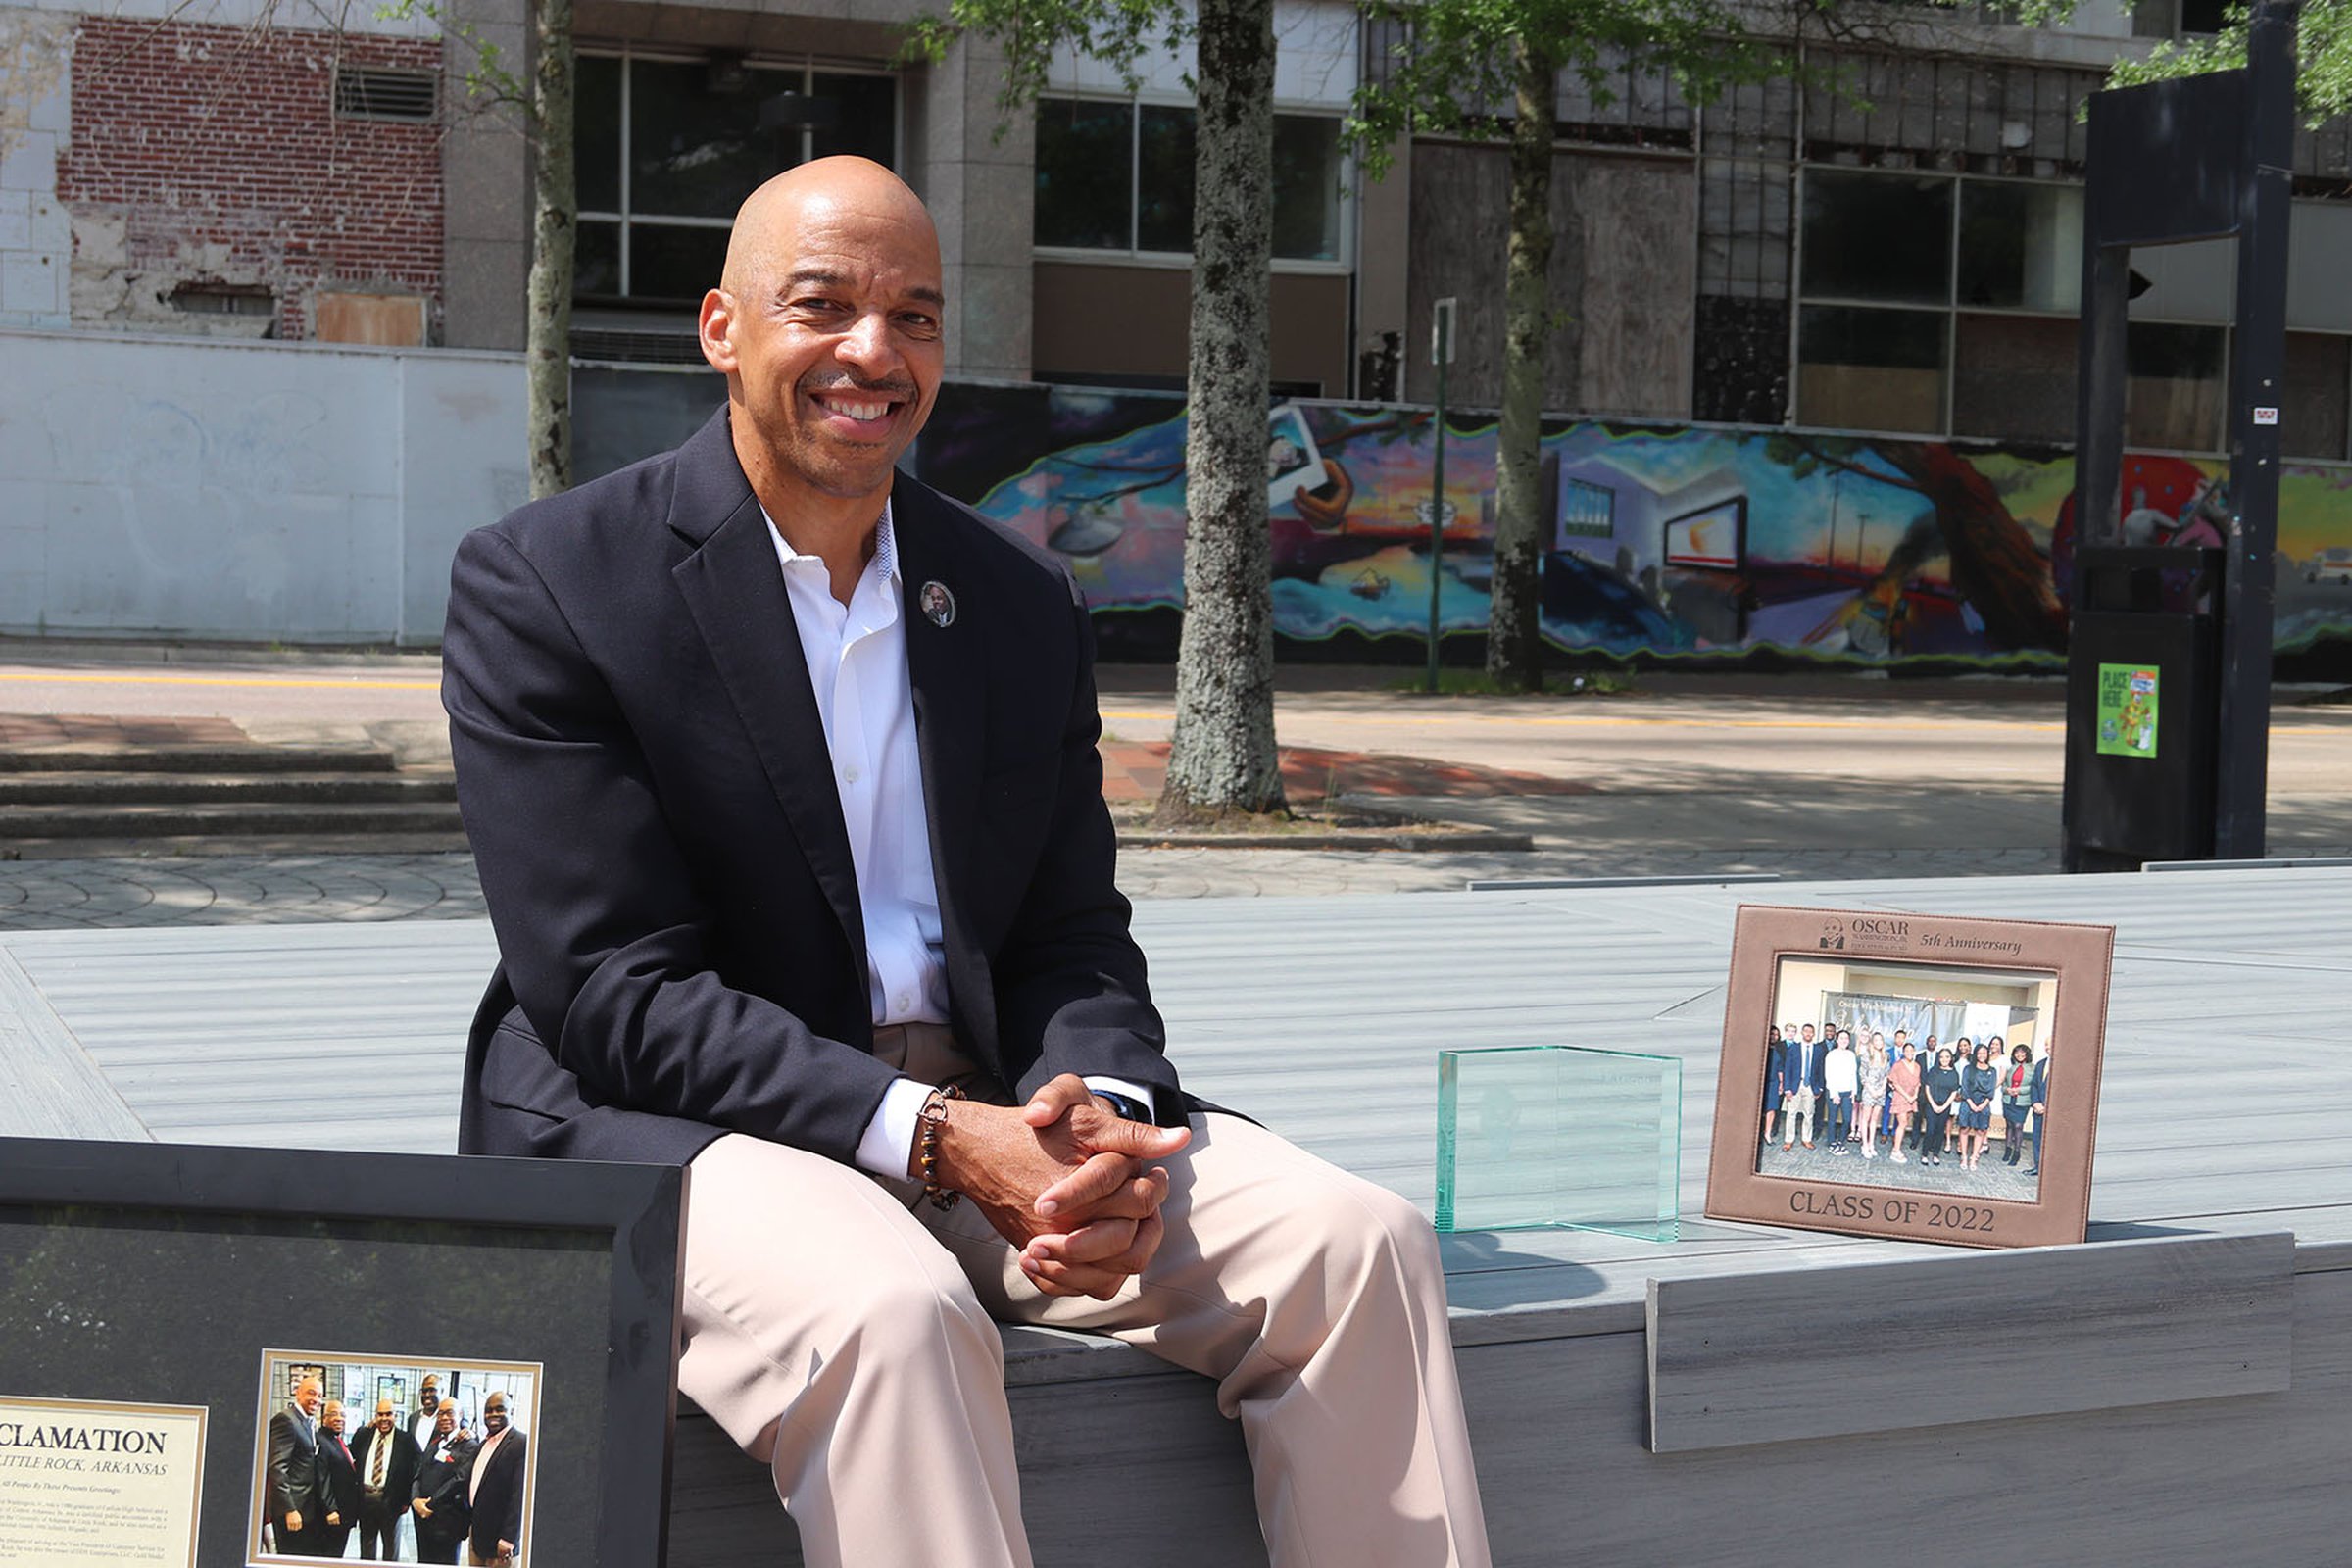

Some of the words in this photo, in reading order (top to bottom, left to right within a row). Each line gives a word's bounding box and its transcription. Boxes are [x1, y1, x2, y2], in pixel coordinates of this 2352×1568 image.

[1852, 918, 1909, 936] OSCAR
[1920, 933, 1941, 947] 5th
[1944, 935, 2022, 956] Anniversary
[1790, 1191, 1874, 1219] CLASS
[1884, 1200, 1920, 1224] OF
[1928, 1204, 1995, 1232] 2022
[0, 1423, 167, 1454] CLAMATION
[44, 1457, 86, 1472] ROCK,
[90, 1461, 168, 1475] ARKANSAS
